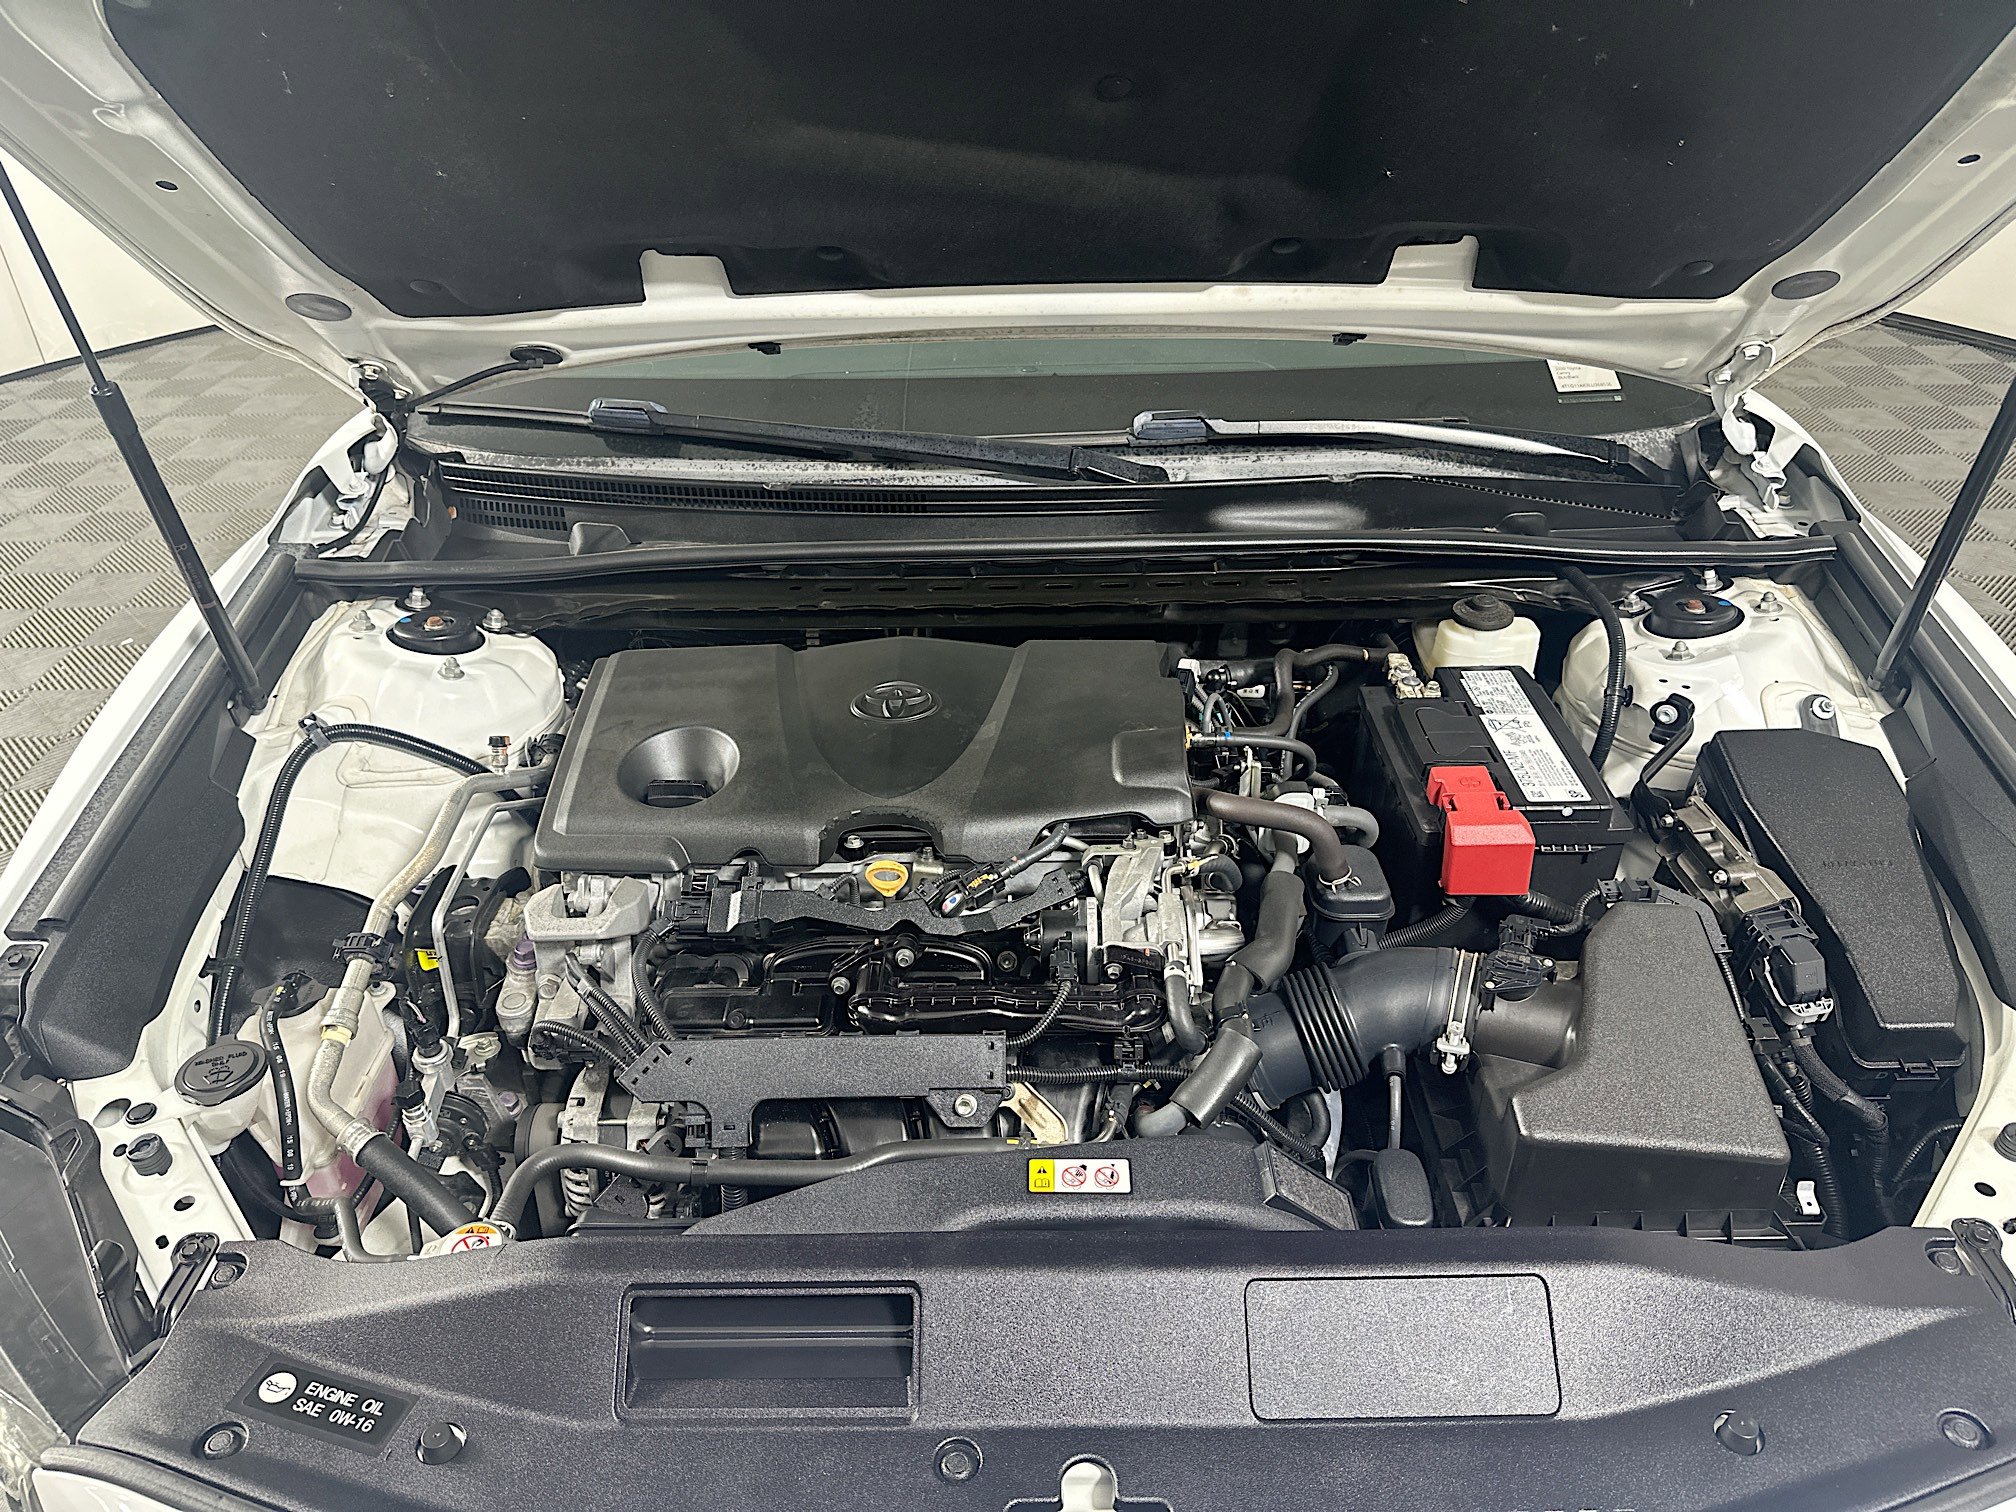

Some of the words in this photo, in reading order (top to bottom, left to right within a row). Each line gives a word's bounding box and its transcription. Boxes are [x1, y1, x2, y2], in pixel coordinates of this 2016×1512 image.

[292, 1398, 326, 1418] SAE
[328, 1409, 376, 1433] 0W-16
[304, 1381, 359, 1407] ENGINE
[361, 1398, 384, 1416] OIL
